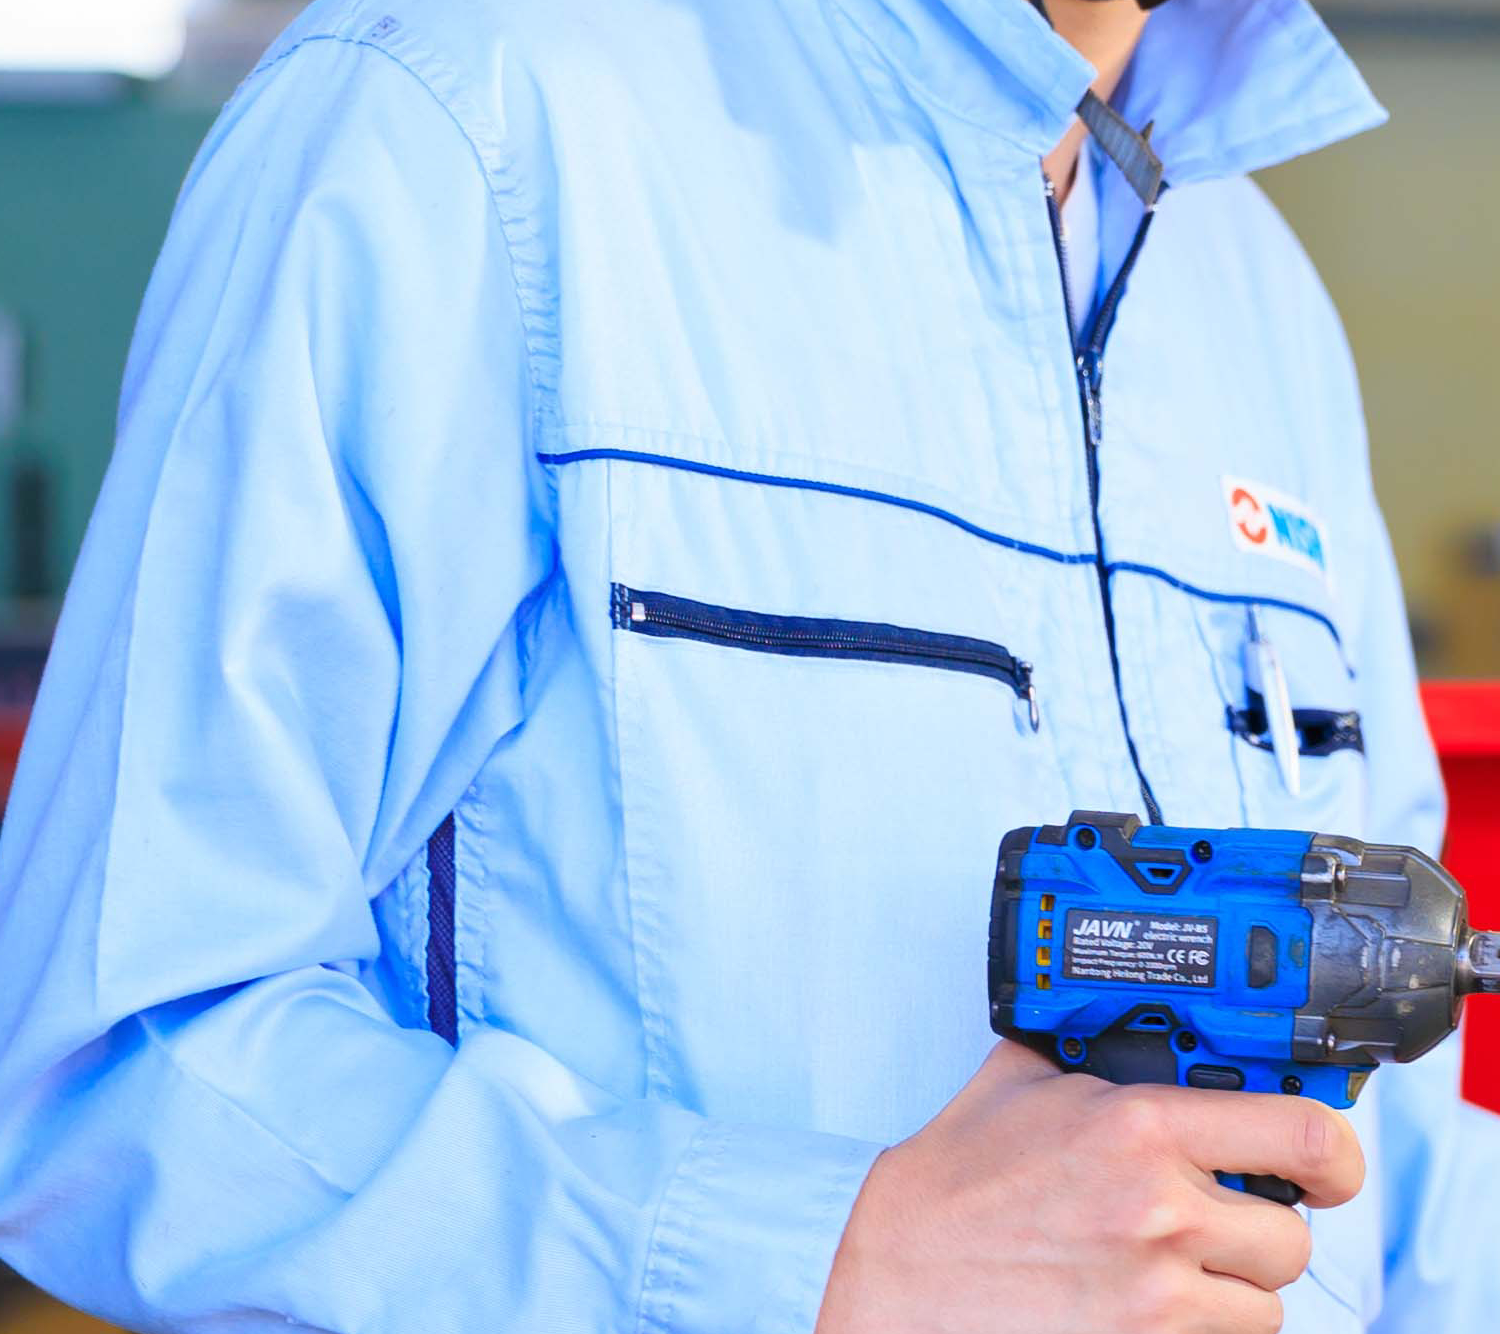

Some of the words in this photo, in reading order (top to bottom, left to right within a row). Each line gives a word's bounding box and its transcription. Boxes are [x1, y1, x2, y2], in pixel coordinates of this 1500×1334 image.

[1072, 919, 1133, 939] JAVN
[1143, 931, 1176, 942] electric
[1177, 933, 1213, 944] wrench
[1167, 949, 1185, 964] CE
[1147, 971, 1172, 982] Trade
